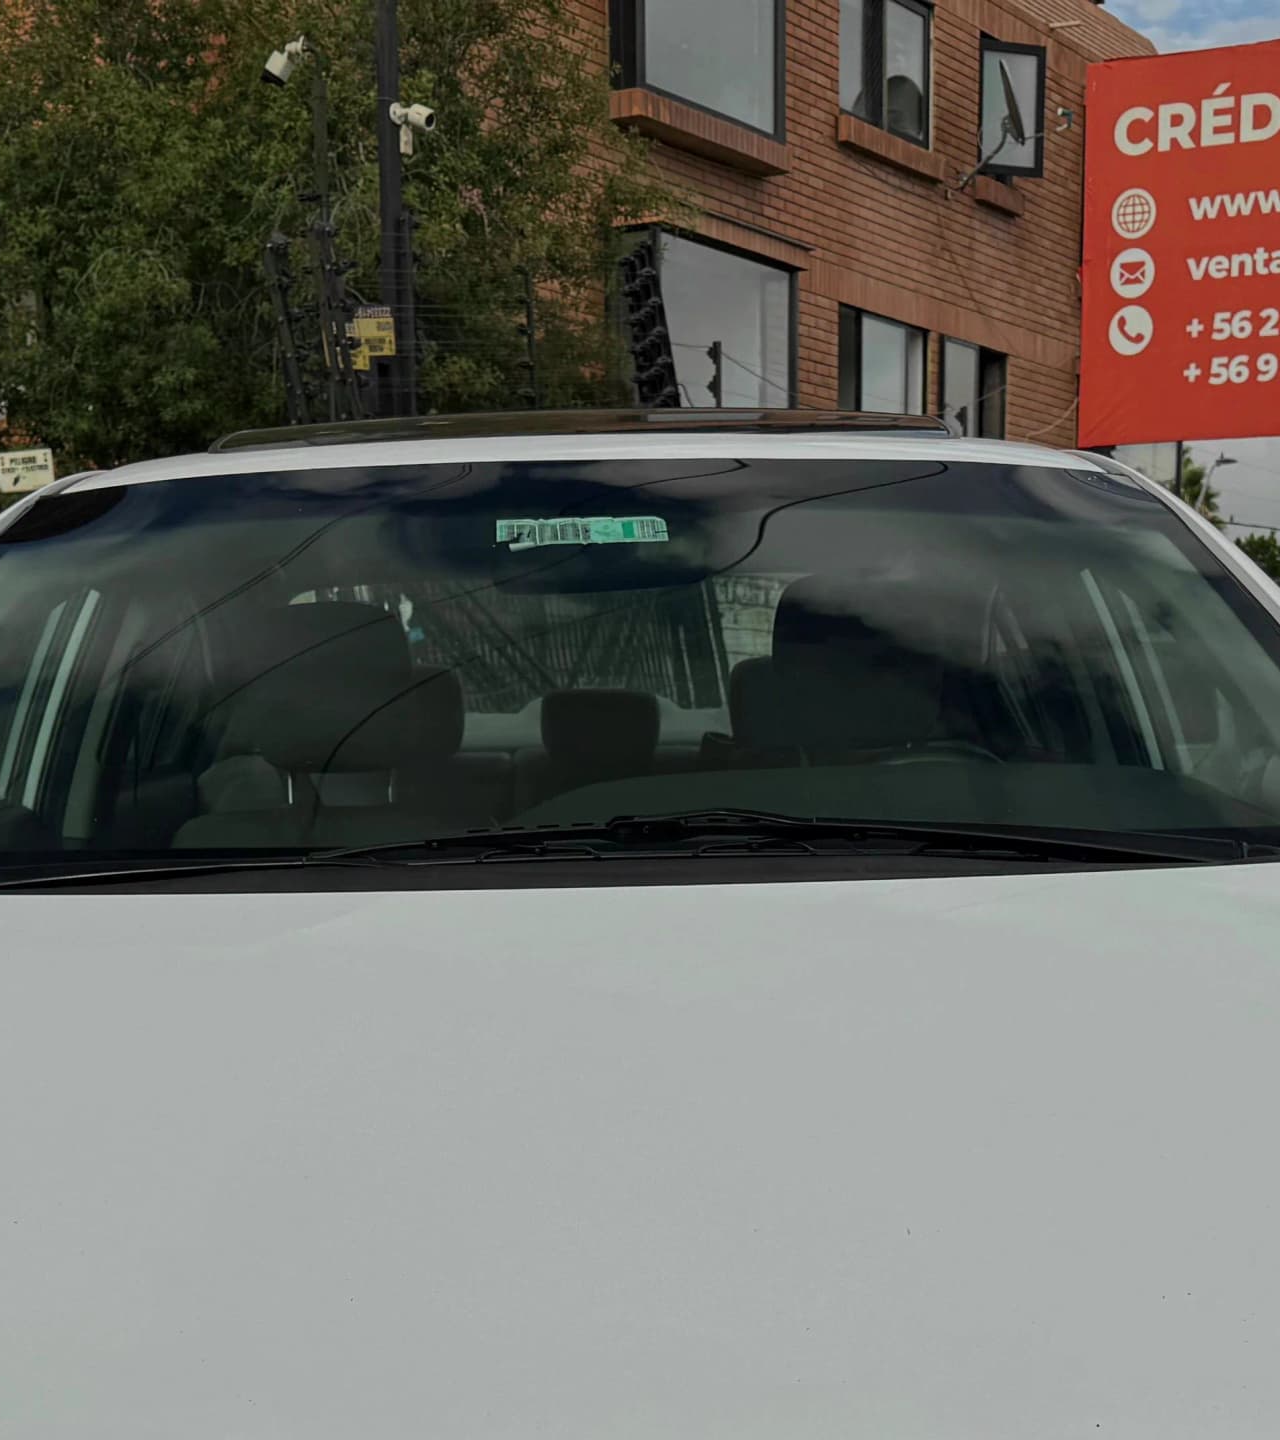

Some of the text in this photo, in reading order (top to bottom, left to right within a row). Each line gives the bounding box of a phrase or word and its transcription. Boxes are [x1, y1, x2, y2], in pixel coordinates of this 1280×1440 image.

[1211, 309, 1253, 341] 56
[1258, 307, 1280, 337] 2
[1208, 354, 1250, 385] 56
[1256, 352, 1279, 382] 9
